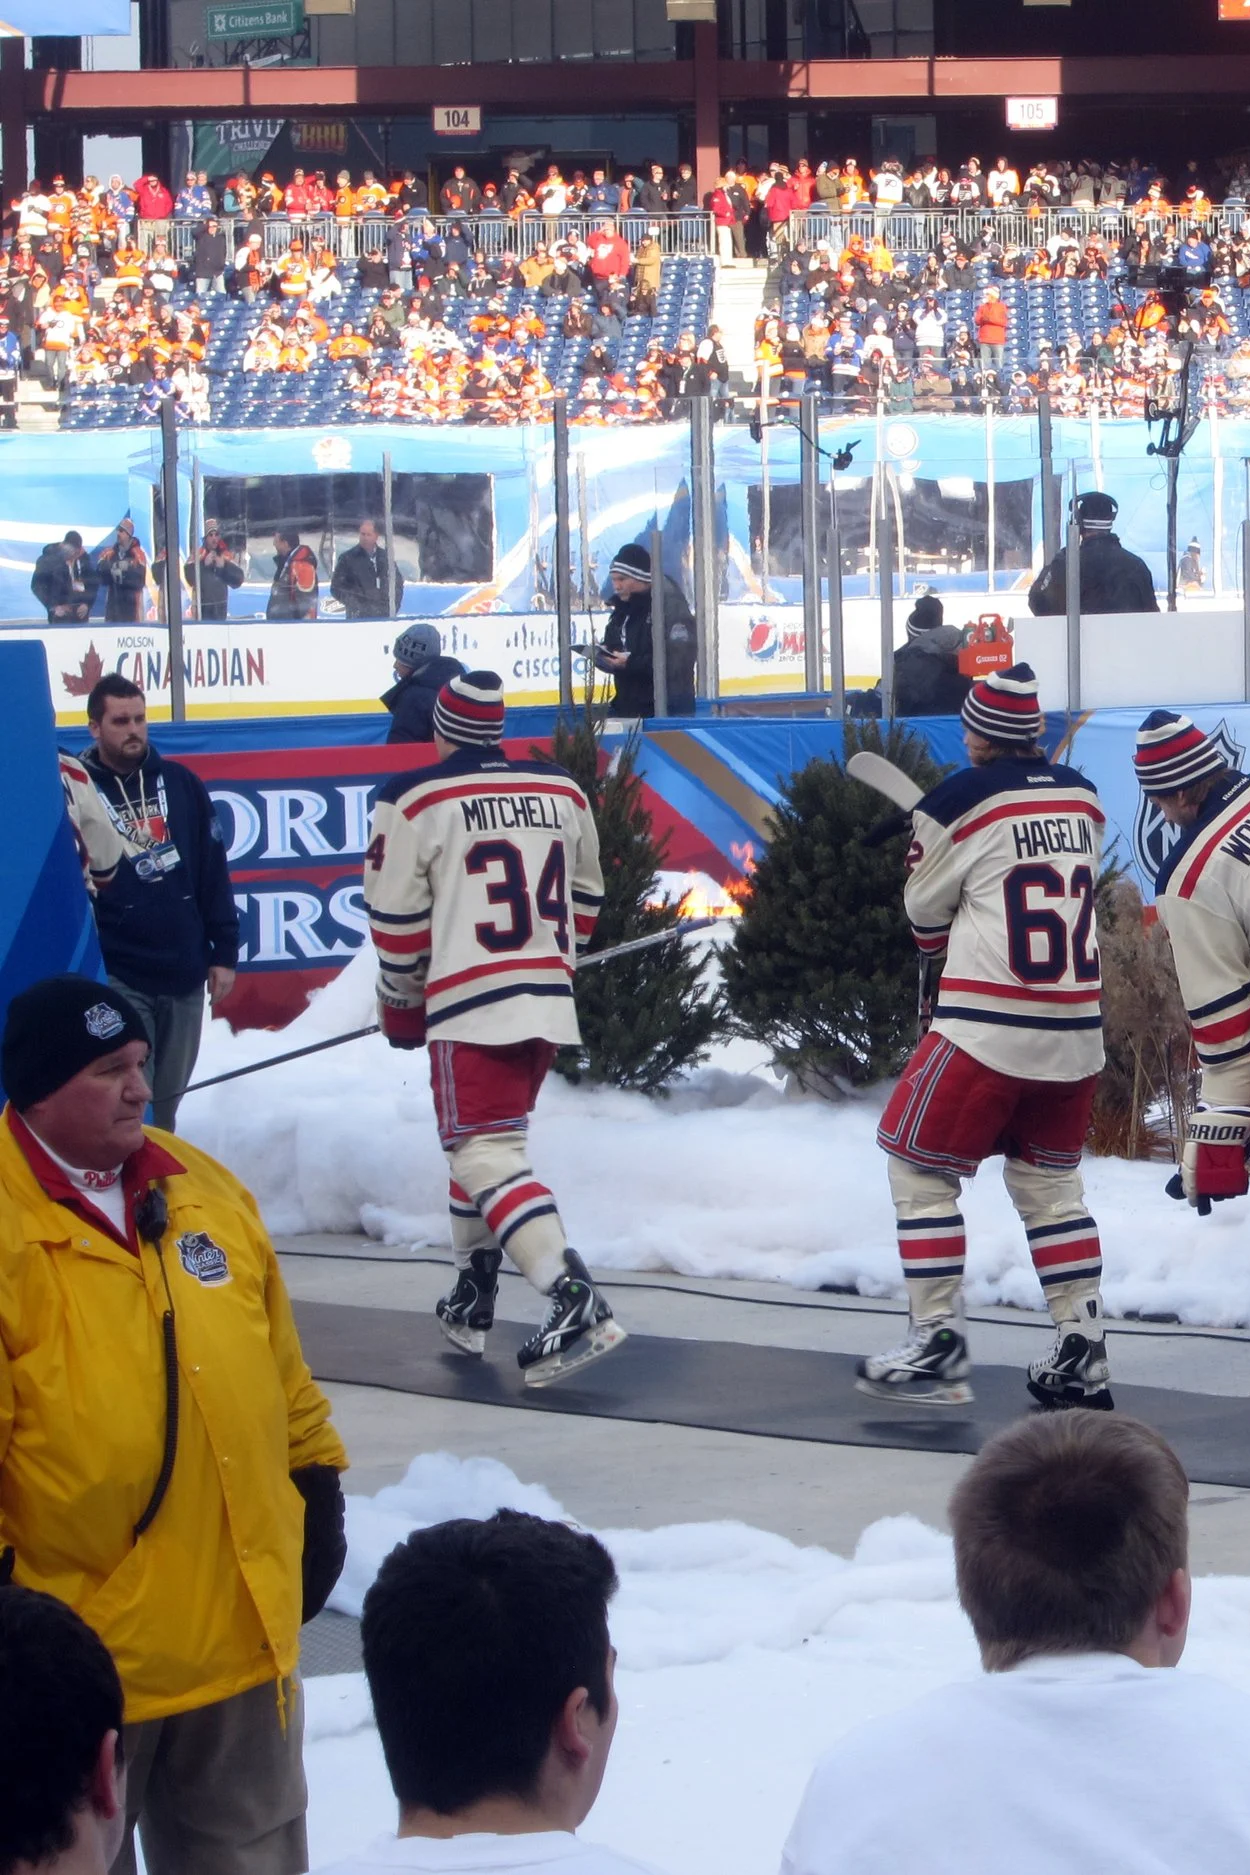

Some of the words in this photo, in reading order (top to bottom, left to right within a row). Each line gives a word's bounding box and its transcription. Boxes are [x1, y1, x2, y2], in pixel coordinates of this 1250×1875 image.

[228, 14, 264, 28] Citizens
[265, 11, 288, 24] Bank
[444, 110, 470, 127] 104
[1020, 103, 1043, 119] 105
[117, 636, 154, 648] MOLSON
[1222, 777, 1250, 801] Reebok
[460, 795, 562, 832] MITCHELL
[1012, 818, 1093, 859] HAGELIN
[464, 838, 569, 955] 34
[1003, 863, 1099, 984] 62
